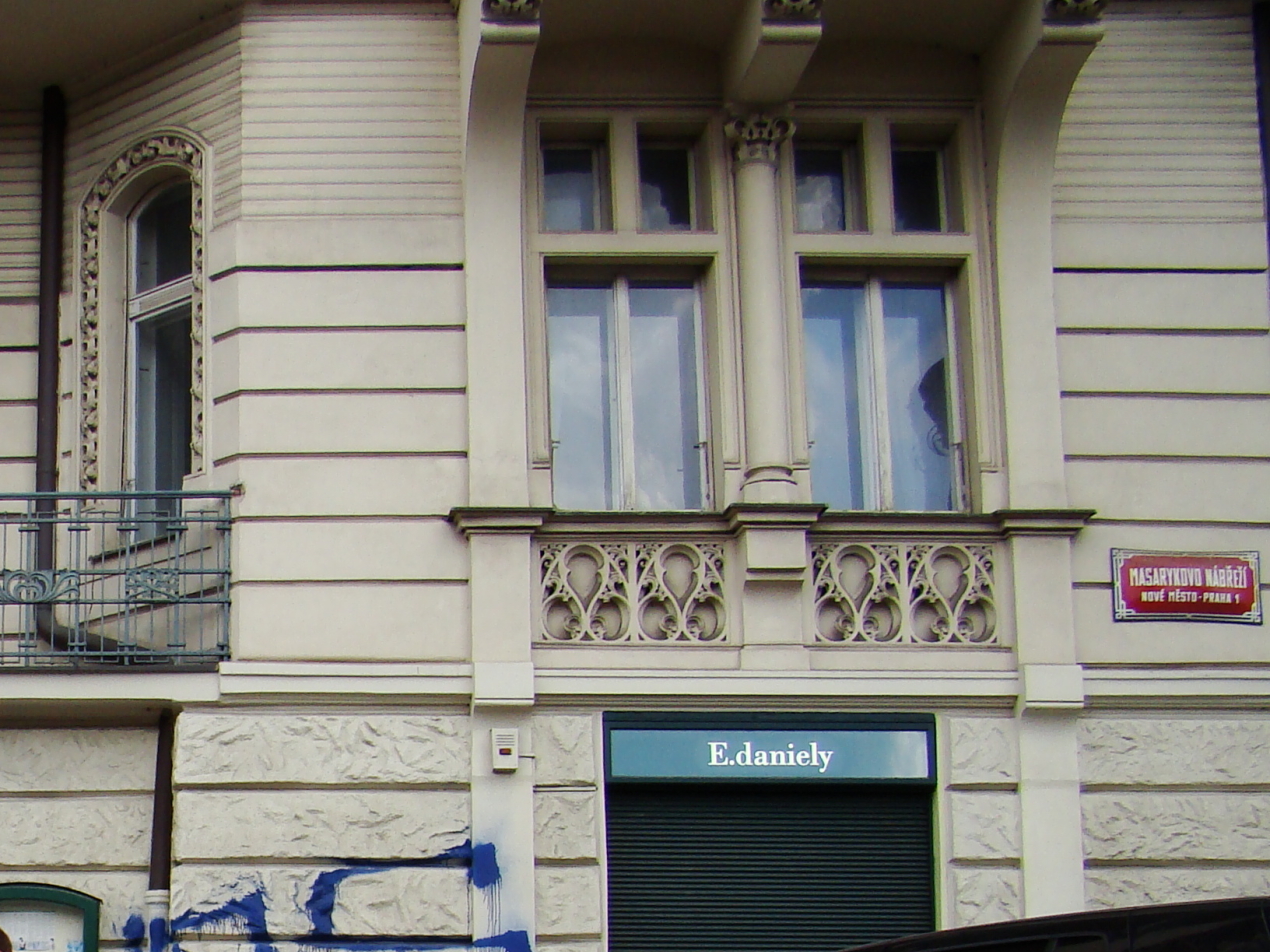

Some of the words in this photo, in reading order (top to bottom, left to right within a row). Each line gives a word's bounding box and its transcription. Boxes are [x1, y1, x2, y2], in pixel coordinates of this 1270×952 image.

[1130, 568, 1203, 587] MASARYKOVO
[1205, 565, 1248, 588] NÁBŘEŽÍ
[1141, 589, 1164, 602] NOVÉ
[1168, 589, 1197, 603] MĚSTO
[1203, 592, 1232, 604] PRAHA
[1235, 594, 1240, 604] 1
[707, 741, 834, 773] E.daniely
